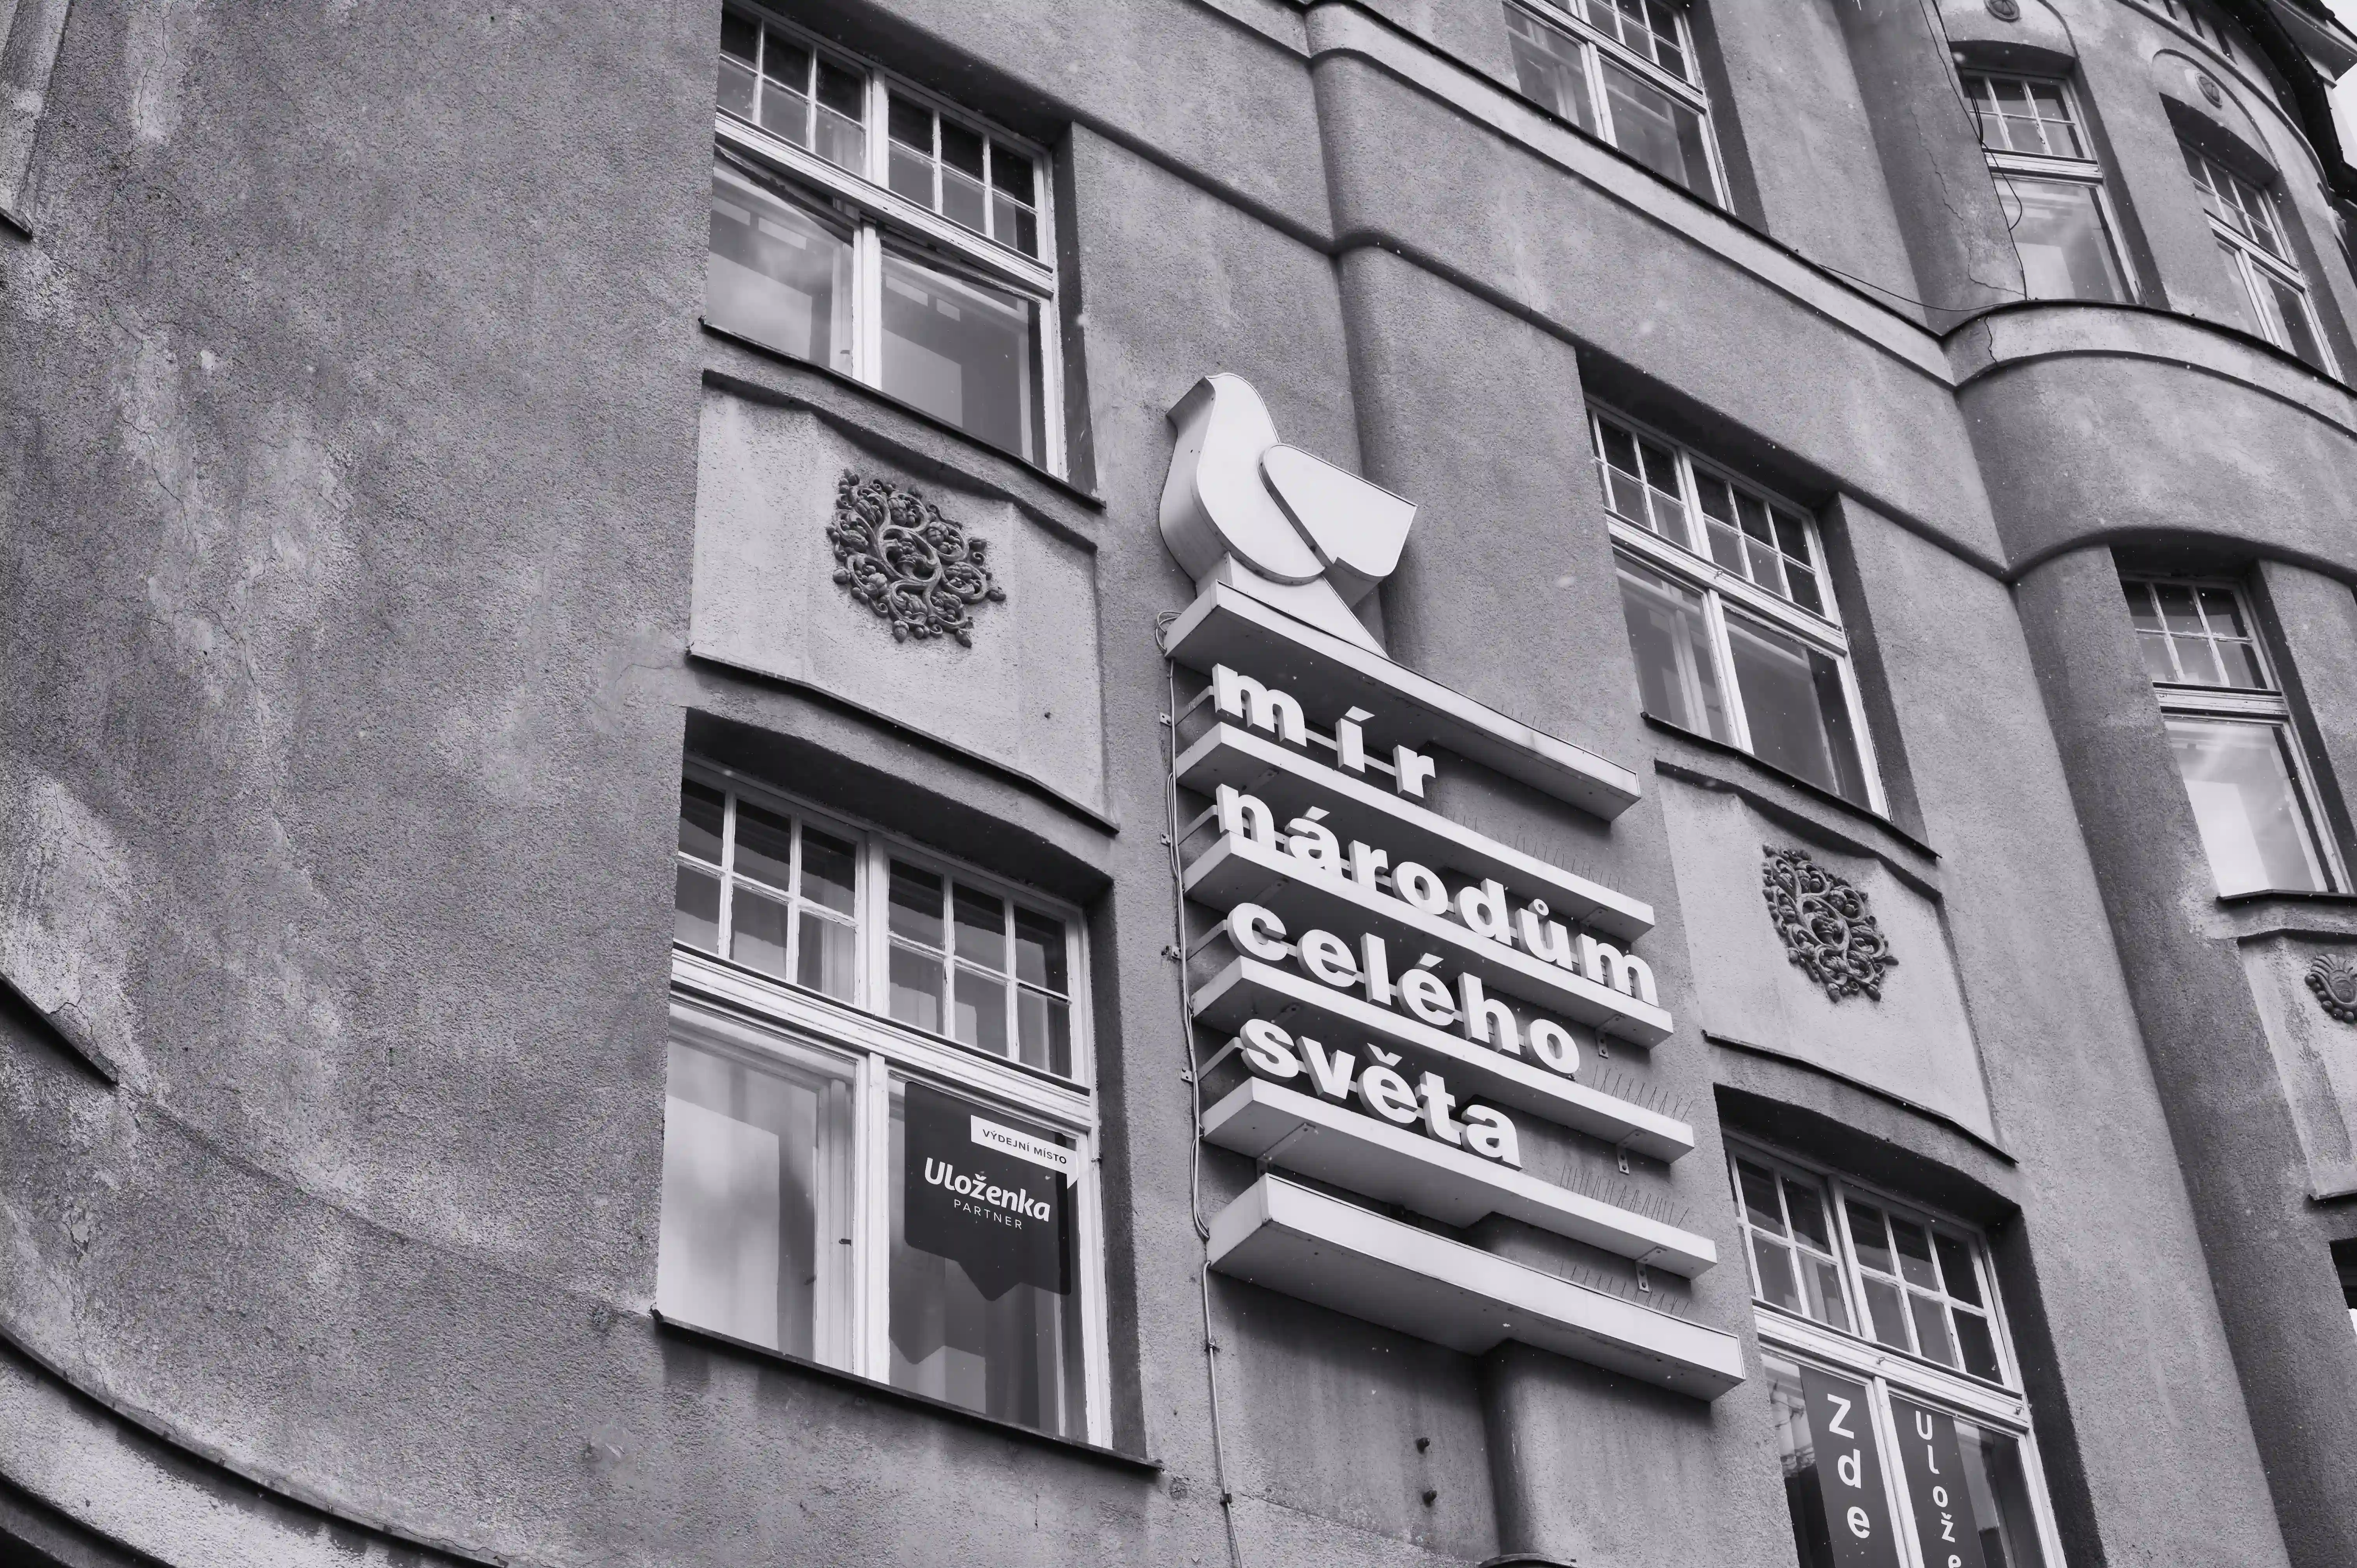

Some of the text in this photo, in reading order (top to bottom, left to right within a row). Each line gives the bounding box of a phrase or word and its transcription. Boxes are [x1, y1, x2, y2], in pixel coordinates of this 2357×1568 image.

[1212, 663, 1436, 797] mír
[1216, 783, 1659, 1008] národům
[1227, 902, 1580, 1077] celého
[983, 1129, 1067, 1164] VÝDEJNÍ MÍSTO
[1240, 1018, 1522, 1170] světa
[925, 1157, 1050, 1222] Uloženka
[954, 1199, 1022, 1229] PARTNER
[1827, 1394, 1870, 1538] Zde
